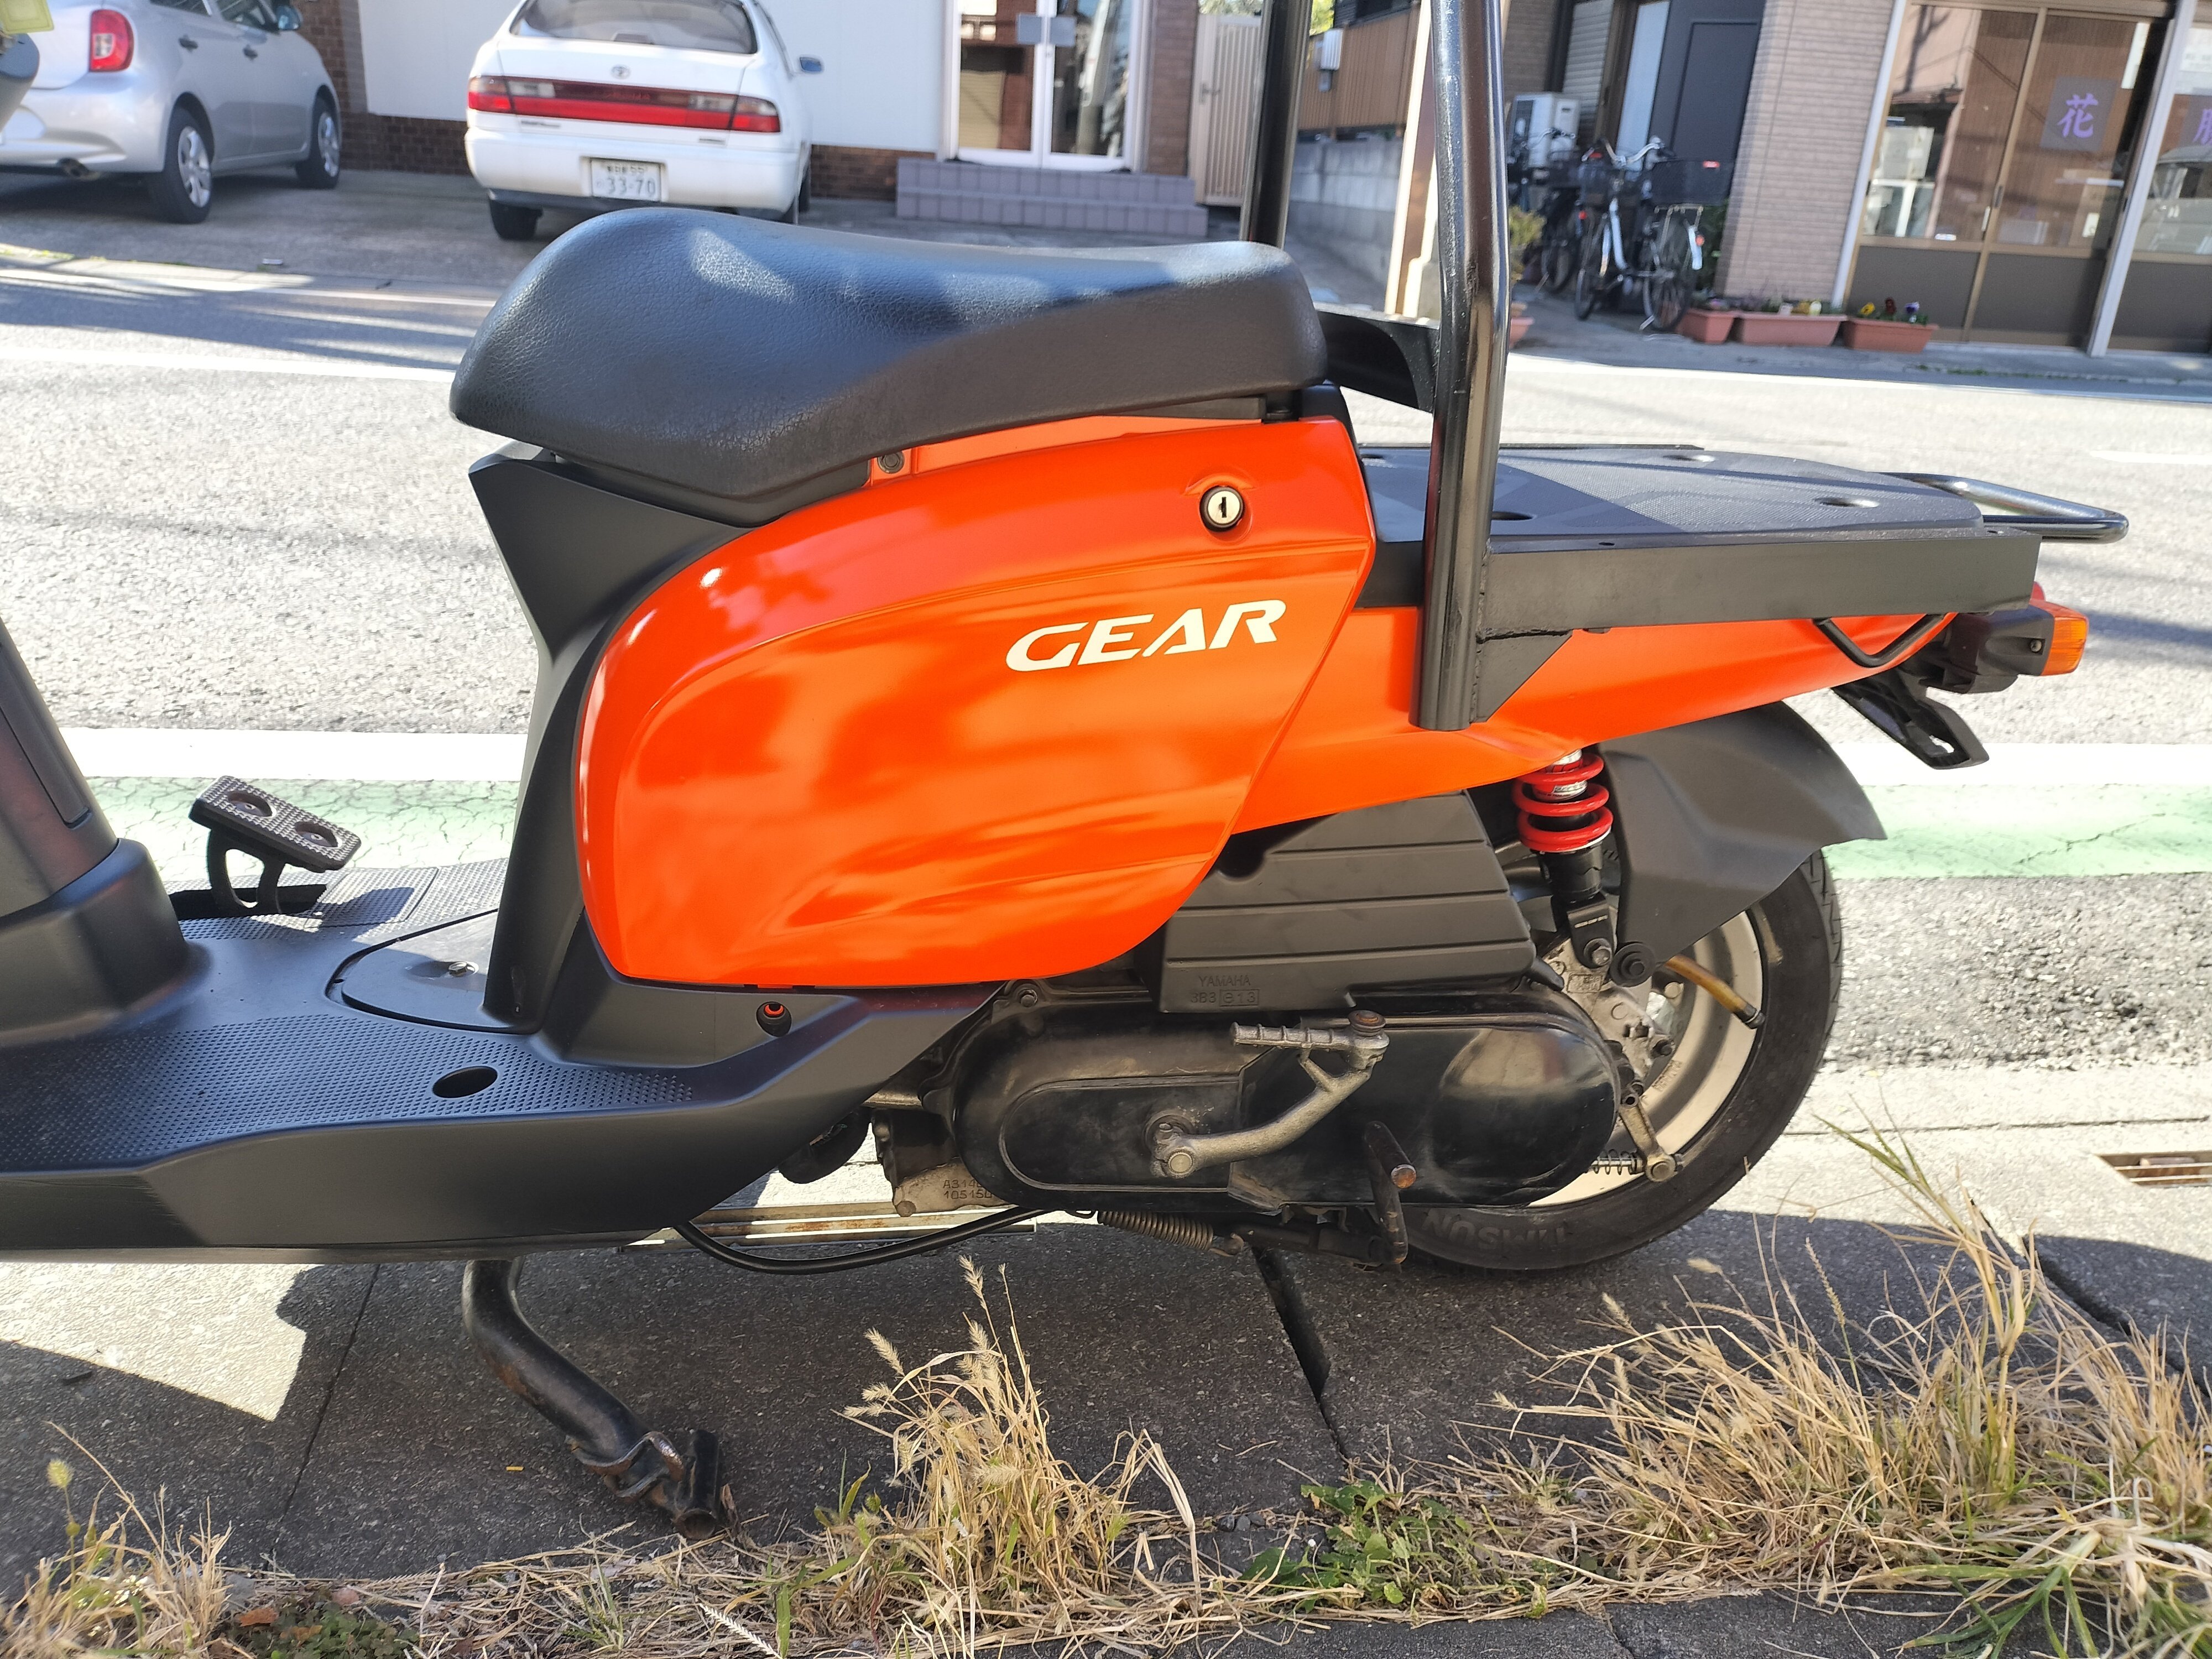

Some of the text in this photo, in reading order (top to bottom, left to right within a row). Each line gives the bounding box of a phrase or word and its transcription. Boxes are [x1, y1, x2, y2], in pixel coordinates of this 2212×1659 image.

[2058, 93, 2099, 138] 花
[606, 176, 656, 197] 33-70
[1005, 599, 1286, 671] GEAR
[1198, 974, 1251, 987] YAMAHA
[1191, 992, 1217, 1003] 3B3
[1421, 1208, 1567, 1251] TIMSUN
